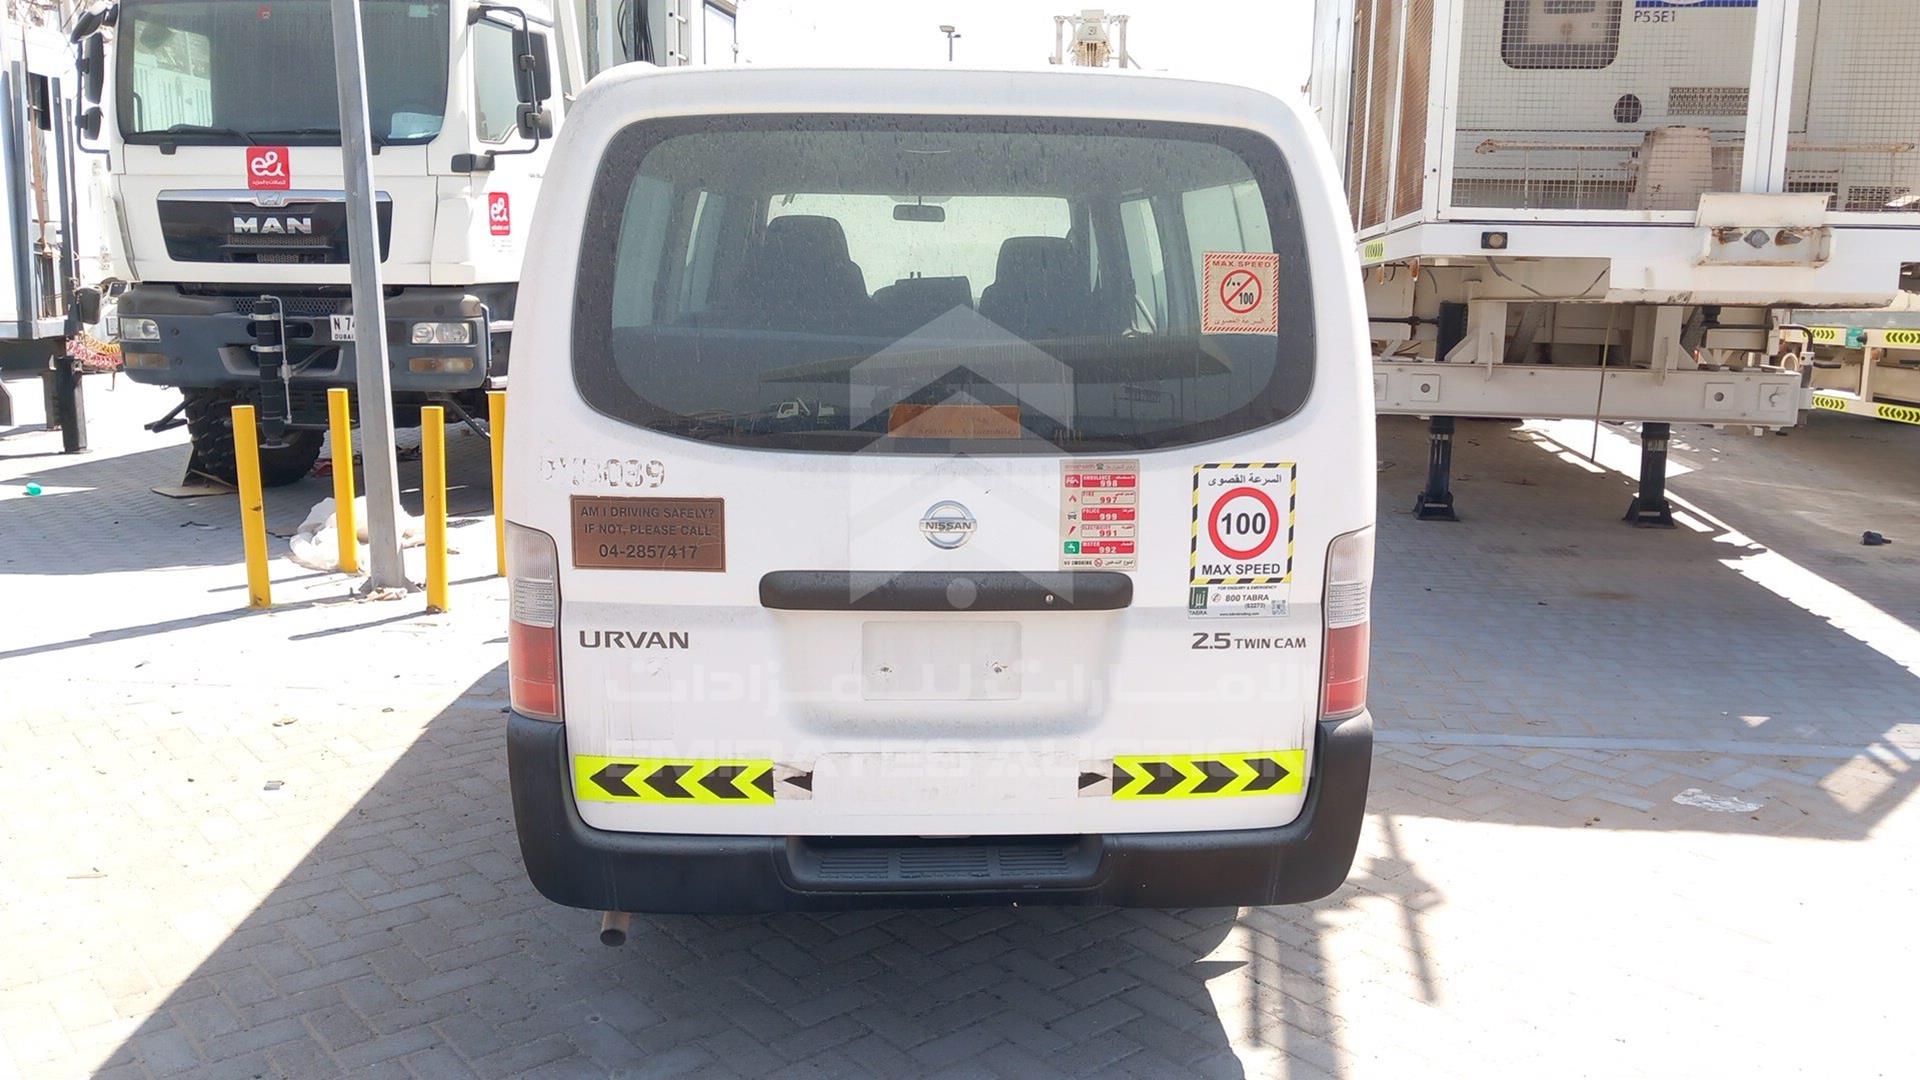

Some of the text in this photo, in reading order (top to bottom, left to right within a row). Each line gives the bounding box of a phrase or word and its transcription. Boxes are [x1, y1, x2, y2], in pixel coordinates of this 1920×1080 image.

[233, 217, 312, 234] MAN
[1239, 292, 1254, 305] 100
[333, 317, 355, 331] N 7
[1208, 473, 1282, 487] السرعة القصوى
[1100, 496, 1118, 504] 997
[581, 507, 598, 516] AM
[610, 507, 659, 517] DRIVING
[663, 508, 714, 518] SAFELY?
[584, 524, 594, 533] IF
[630, 525, 676, 535] PLEASE
[680, 525, 711, 536] CALL
[925, 522, 971, 530] NISSAN
[1221, 512, 1266, 535] 100
[599, 544, 698, 558] 04-2857417
[1202, 563, 1280, 575] MAX SPEED
[1225, 594, 1241, 602] 800
[579, 630, 689, 649] URVAN
[1191, 632, 1306, 649] 2.5 TWIN CAM
